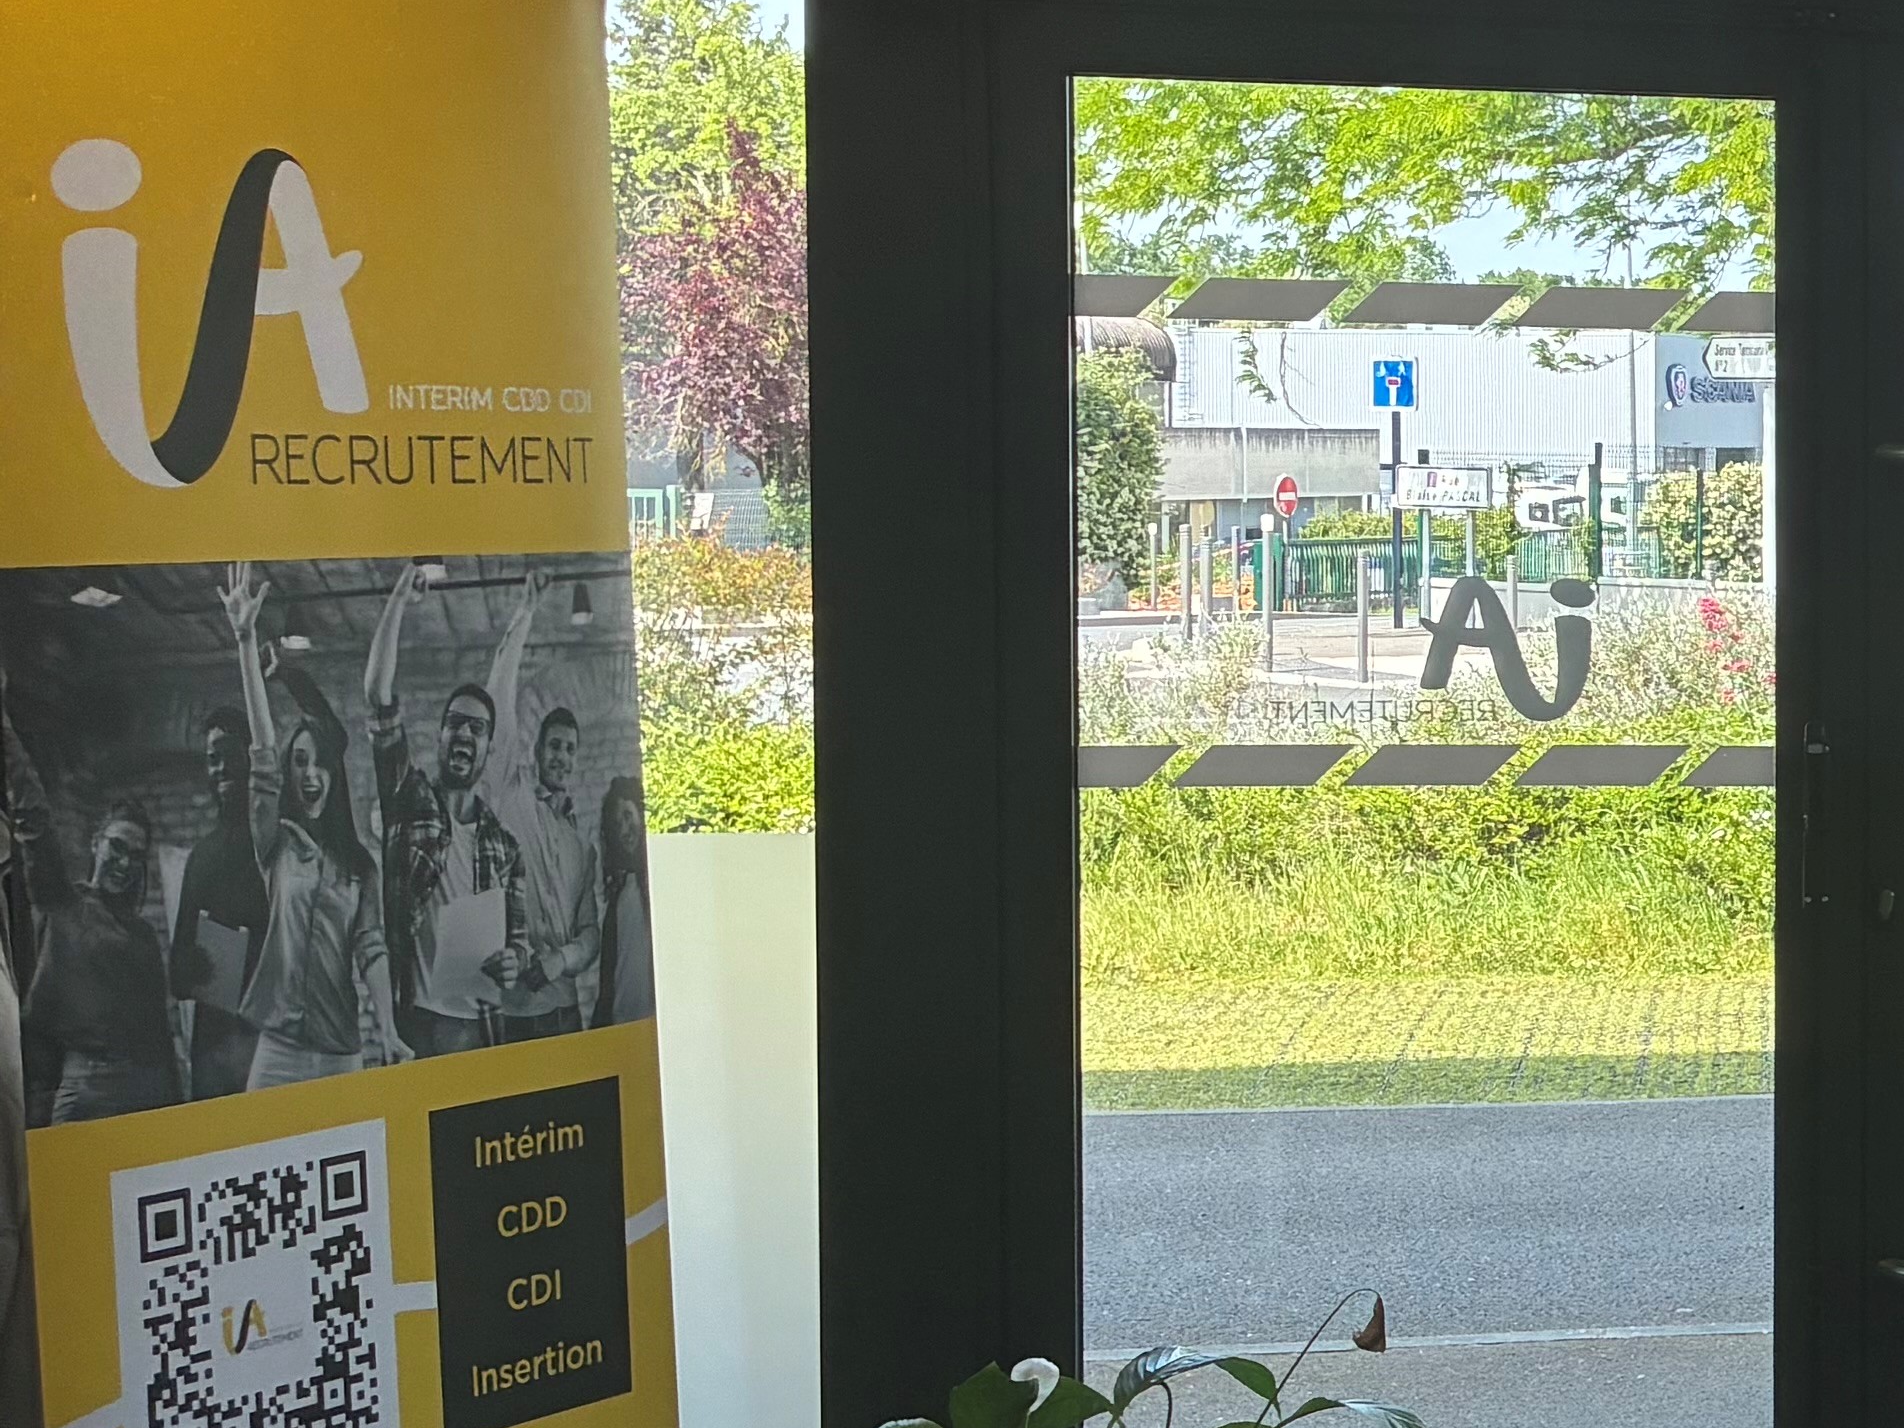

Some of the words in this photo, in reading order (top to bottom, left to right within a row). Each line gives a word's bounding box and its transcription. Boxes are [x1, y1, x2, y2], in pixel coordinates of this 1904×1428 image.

[388, 384, 493, 412] INTERIM
[502, 386, 551, 413] CDD
[560, 388, 592, 414] CDI
[250, 432, 593, 486] RECRUTEMENT
[475, 1121, 584, 1168] Intérim
[497, 1195, 568, 1238] CDD
[507, 1269, 562, 1311] CDI
[472, 1339, 603, 1397] Insertion
